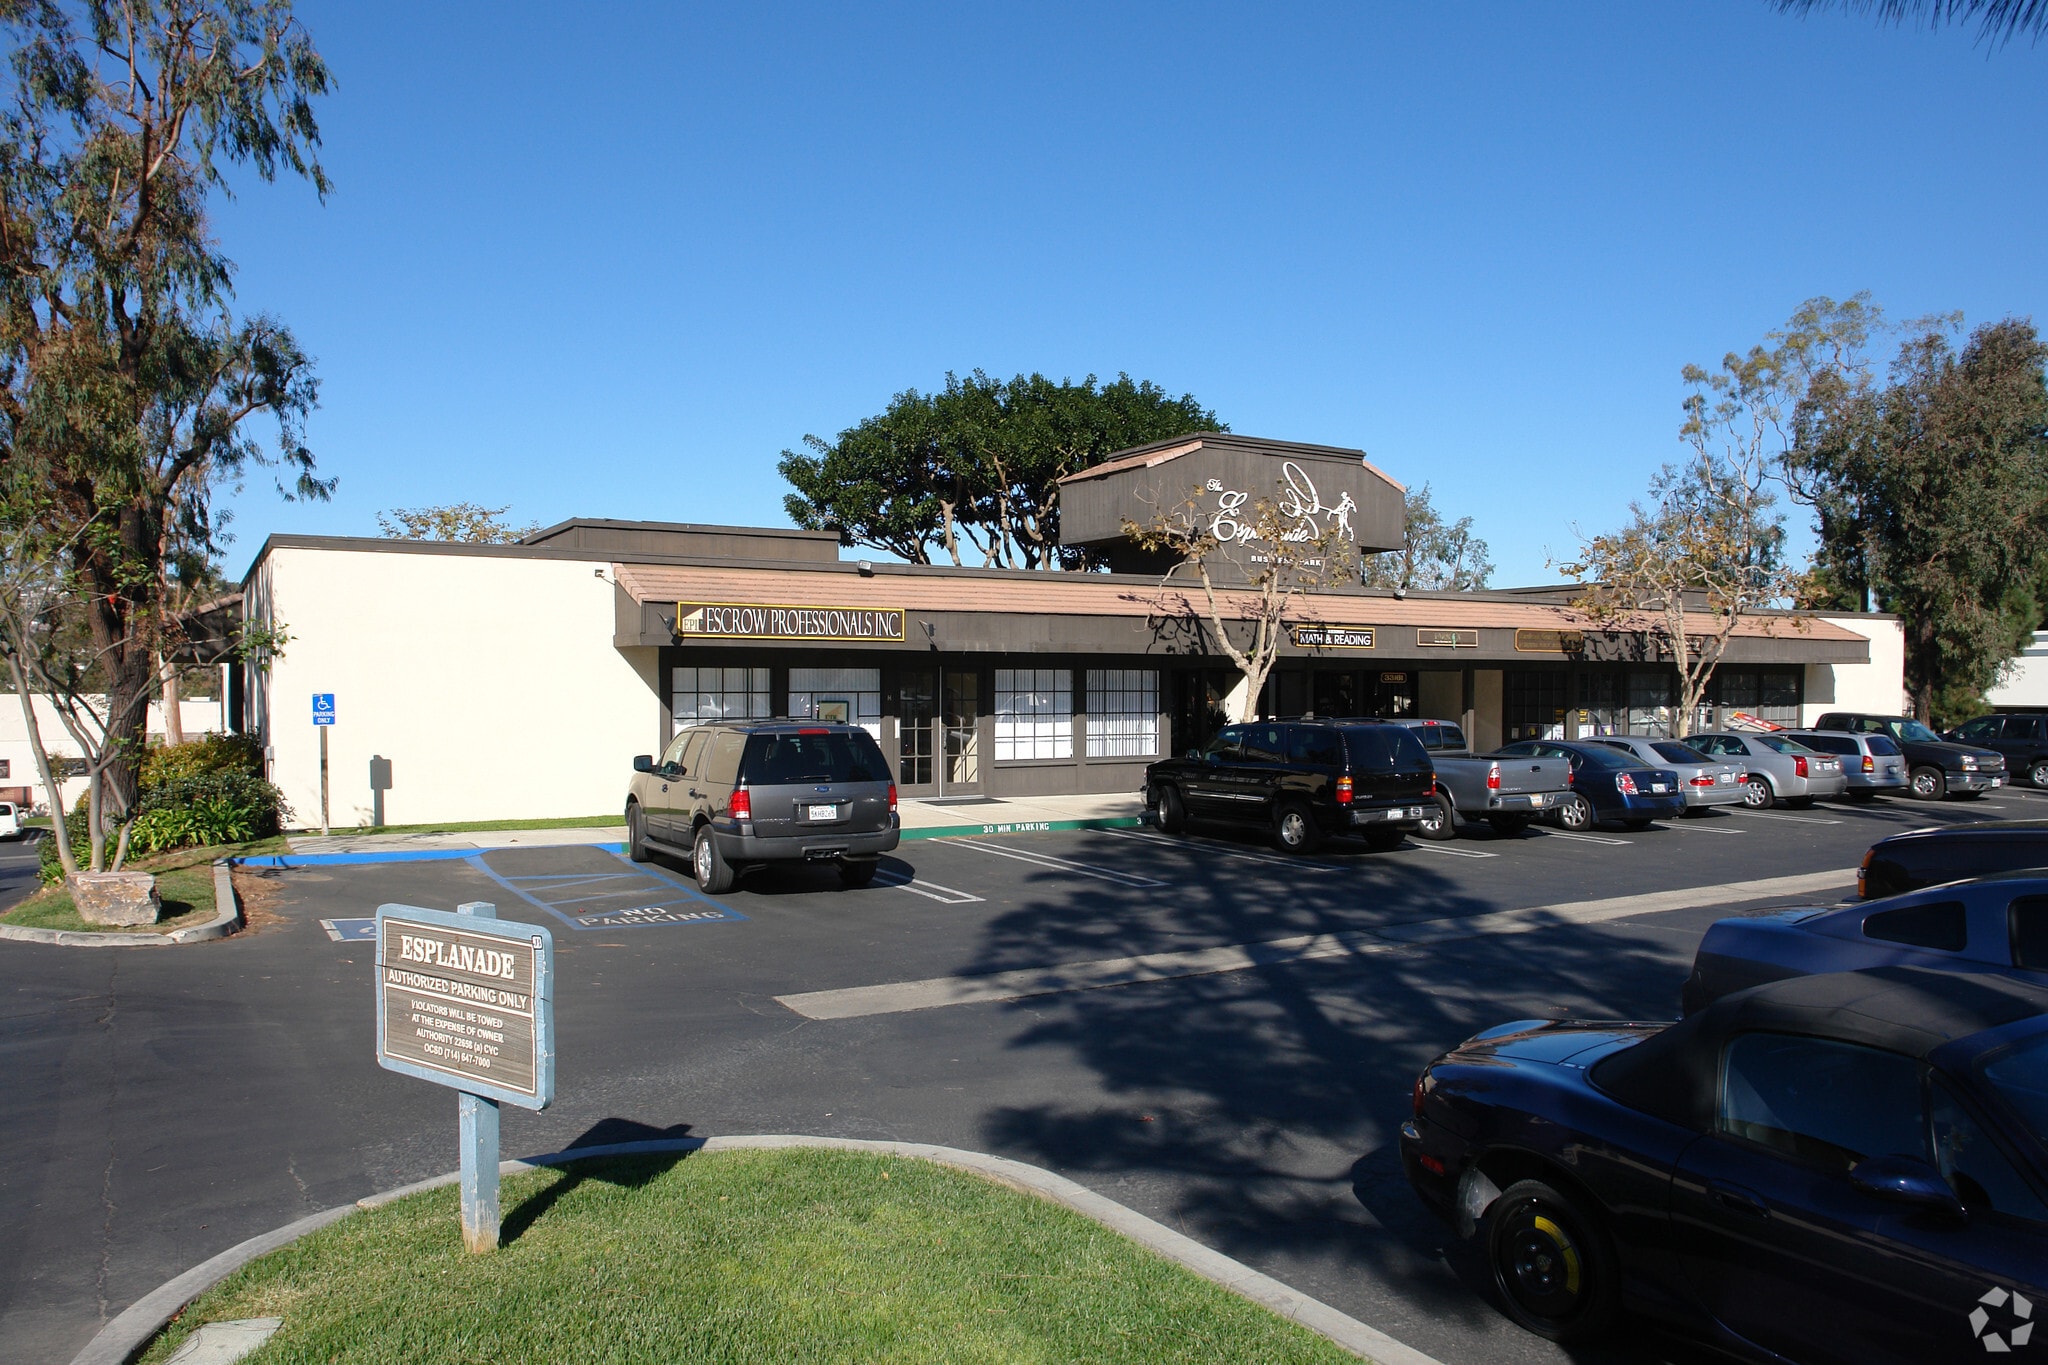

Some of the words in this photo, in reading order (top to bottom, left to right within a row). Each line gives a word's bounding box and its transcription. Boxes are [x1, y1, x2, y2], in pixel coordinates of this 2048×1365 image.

[706, 607, 768, 634] ESCROW
[771, 609, 872, 636] PROFESSIONALS
[1299, 633, 1323, 644] MATH
[1334, 634, 1372, 646] READING
[983, 825, 994, 833] 30
[997, 824, 1011, 833] MIN
[1015, 822, 1050, 831] PARKING
[577, 911, 725, 926] PARKING
[619, 907, 667, 917] NO
[400, 935, 515, 980] ESPLANADE
[388, 969, 449, 993] AUTHORIZED
[451, 981, 497, 1003] PARKING
[498, 992, 527, 1010] ONLY
[411, 999, 448, 1016] VIOLATORS
[449, 1008, 466, 1020] WILL
[466, 1012, 477, 1023] BE
[477, 1014, 503, 1029] TOWED
[411, 1013, 420, 1023] AT
[420, 1015, 435, 1027] THE
[435, 1018, 466, 1034] EXPENSE
[466, 1025, 477, 1036] OF
[416, 1028, 454, 1045] AUTHORITY
